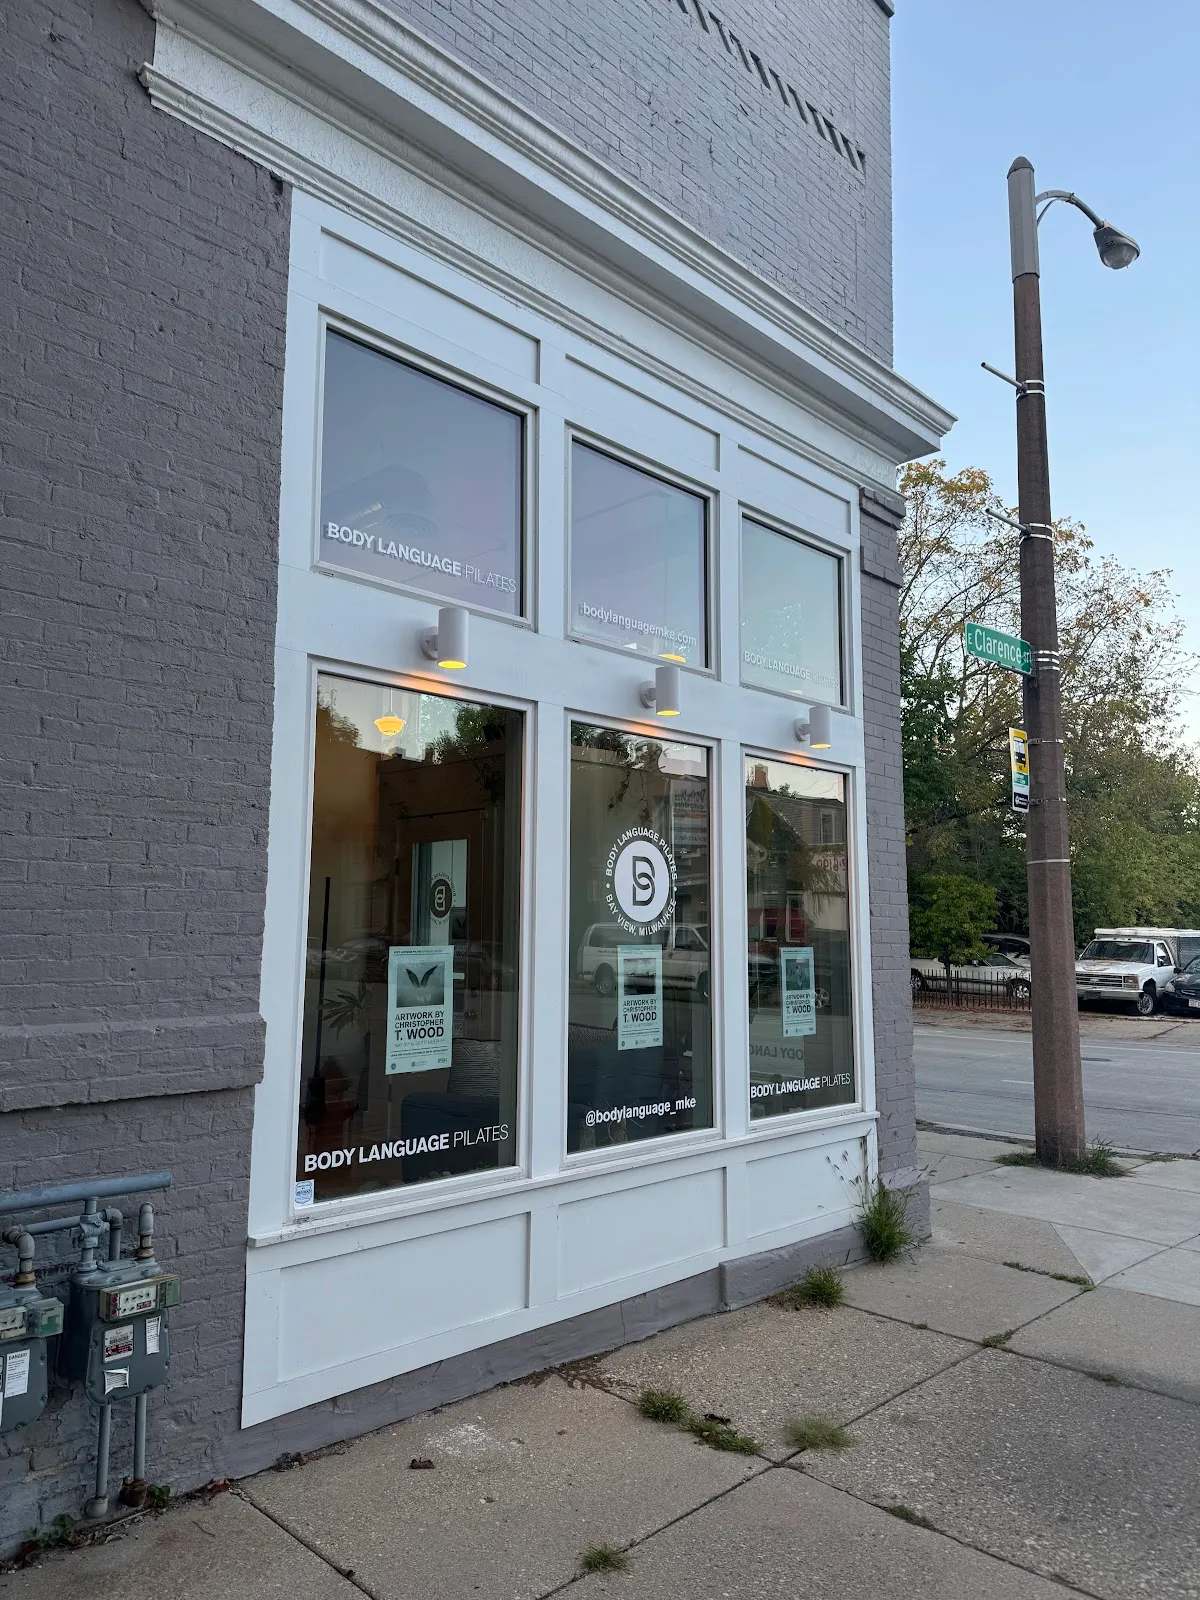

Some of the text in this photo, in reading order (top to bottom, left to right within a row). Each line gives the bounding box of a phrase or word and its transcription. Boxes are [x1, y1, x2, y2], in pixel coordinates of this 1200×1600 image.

[327, 522, 517, 593] BODY LANGUAGE PILATES
[583, 602, 697, 646] bodylanguagemke.com
[968, 633, 973, 645] E
[974, 628, 1022, 664] Clarence
[744, 650, 811, 679] BODY LANGUAGE
[605, 827, 678, 880] BODY LANGUAGE PILATES
[606, 893, 677, 937] BAY VIEW, MILWAUKEE
[394, 1018, 444, 1029] CHRISTOPHER
[395, 1010, 445, 1021] ARTWORK BY
[631, 1011, 657, 1022] WOOD
[792, 1005, 812, 1014] WOOD
[394, 1026, 444, 1040] T. WOOD
[750, 1072, 851, 1099] BODY LANGUAGE PILATES
[585, 1095, 697, 1127] @bodylanguage_mke
[304, 1124, 509, 1173] BODY LANGUAGE PILATES
